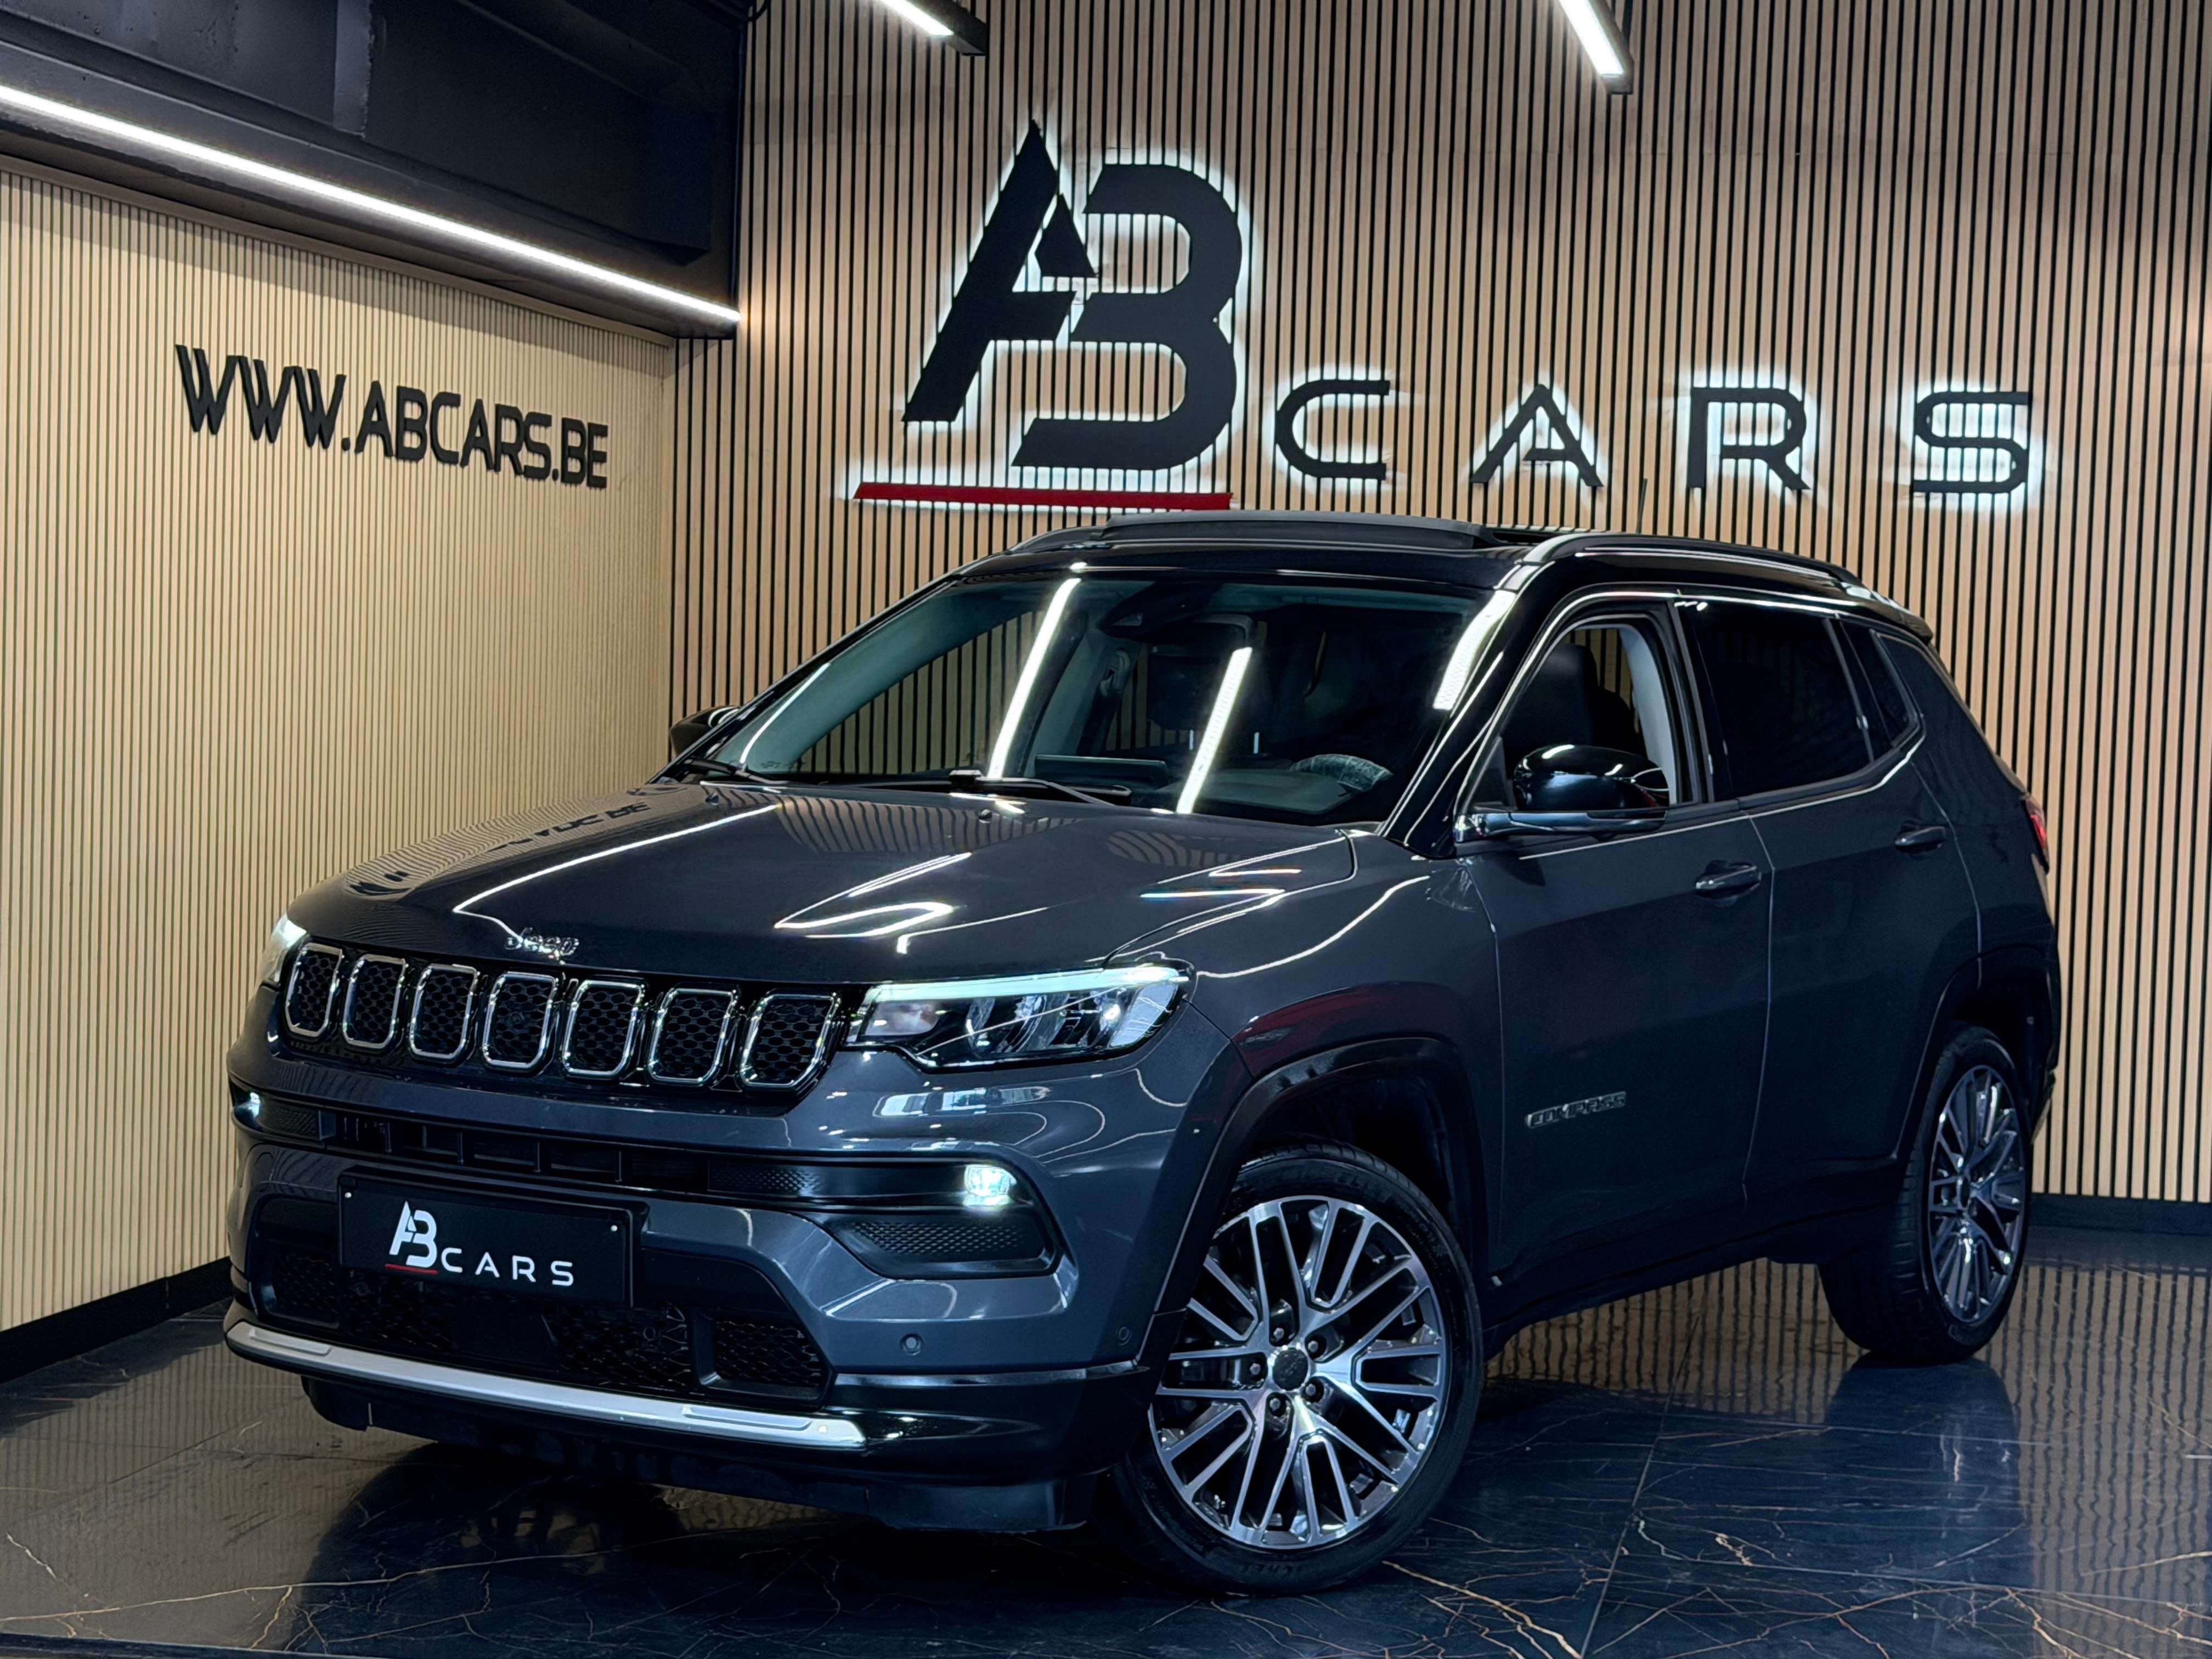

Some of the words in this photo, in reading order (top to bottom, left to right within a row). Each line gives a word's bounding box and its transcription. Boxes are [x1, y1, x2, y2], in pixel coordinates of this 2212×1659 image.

[176, 344, 609, 489] WWW.ABCARS.BE
[1274, 379, 2033, 494] CARS
[441, 1247, 574, 1286] CARS
